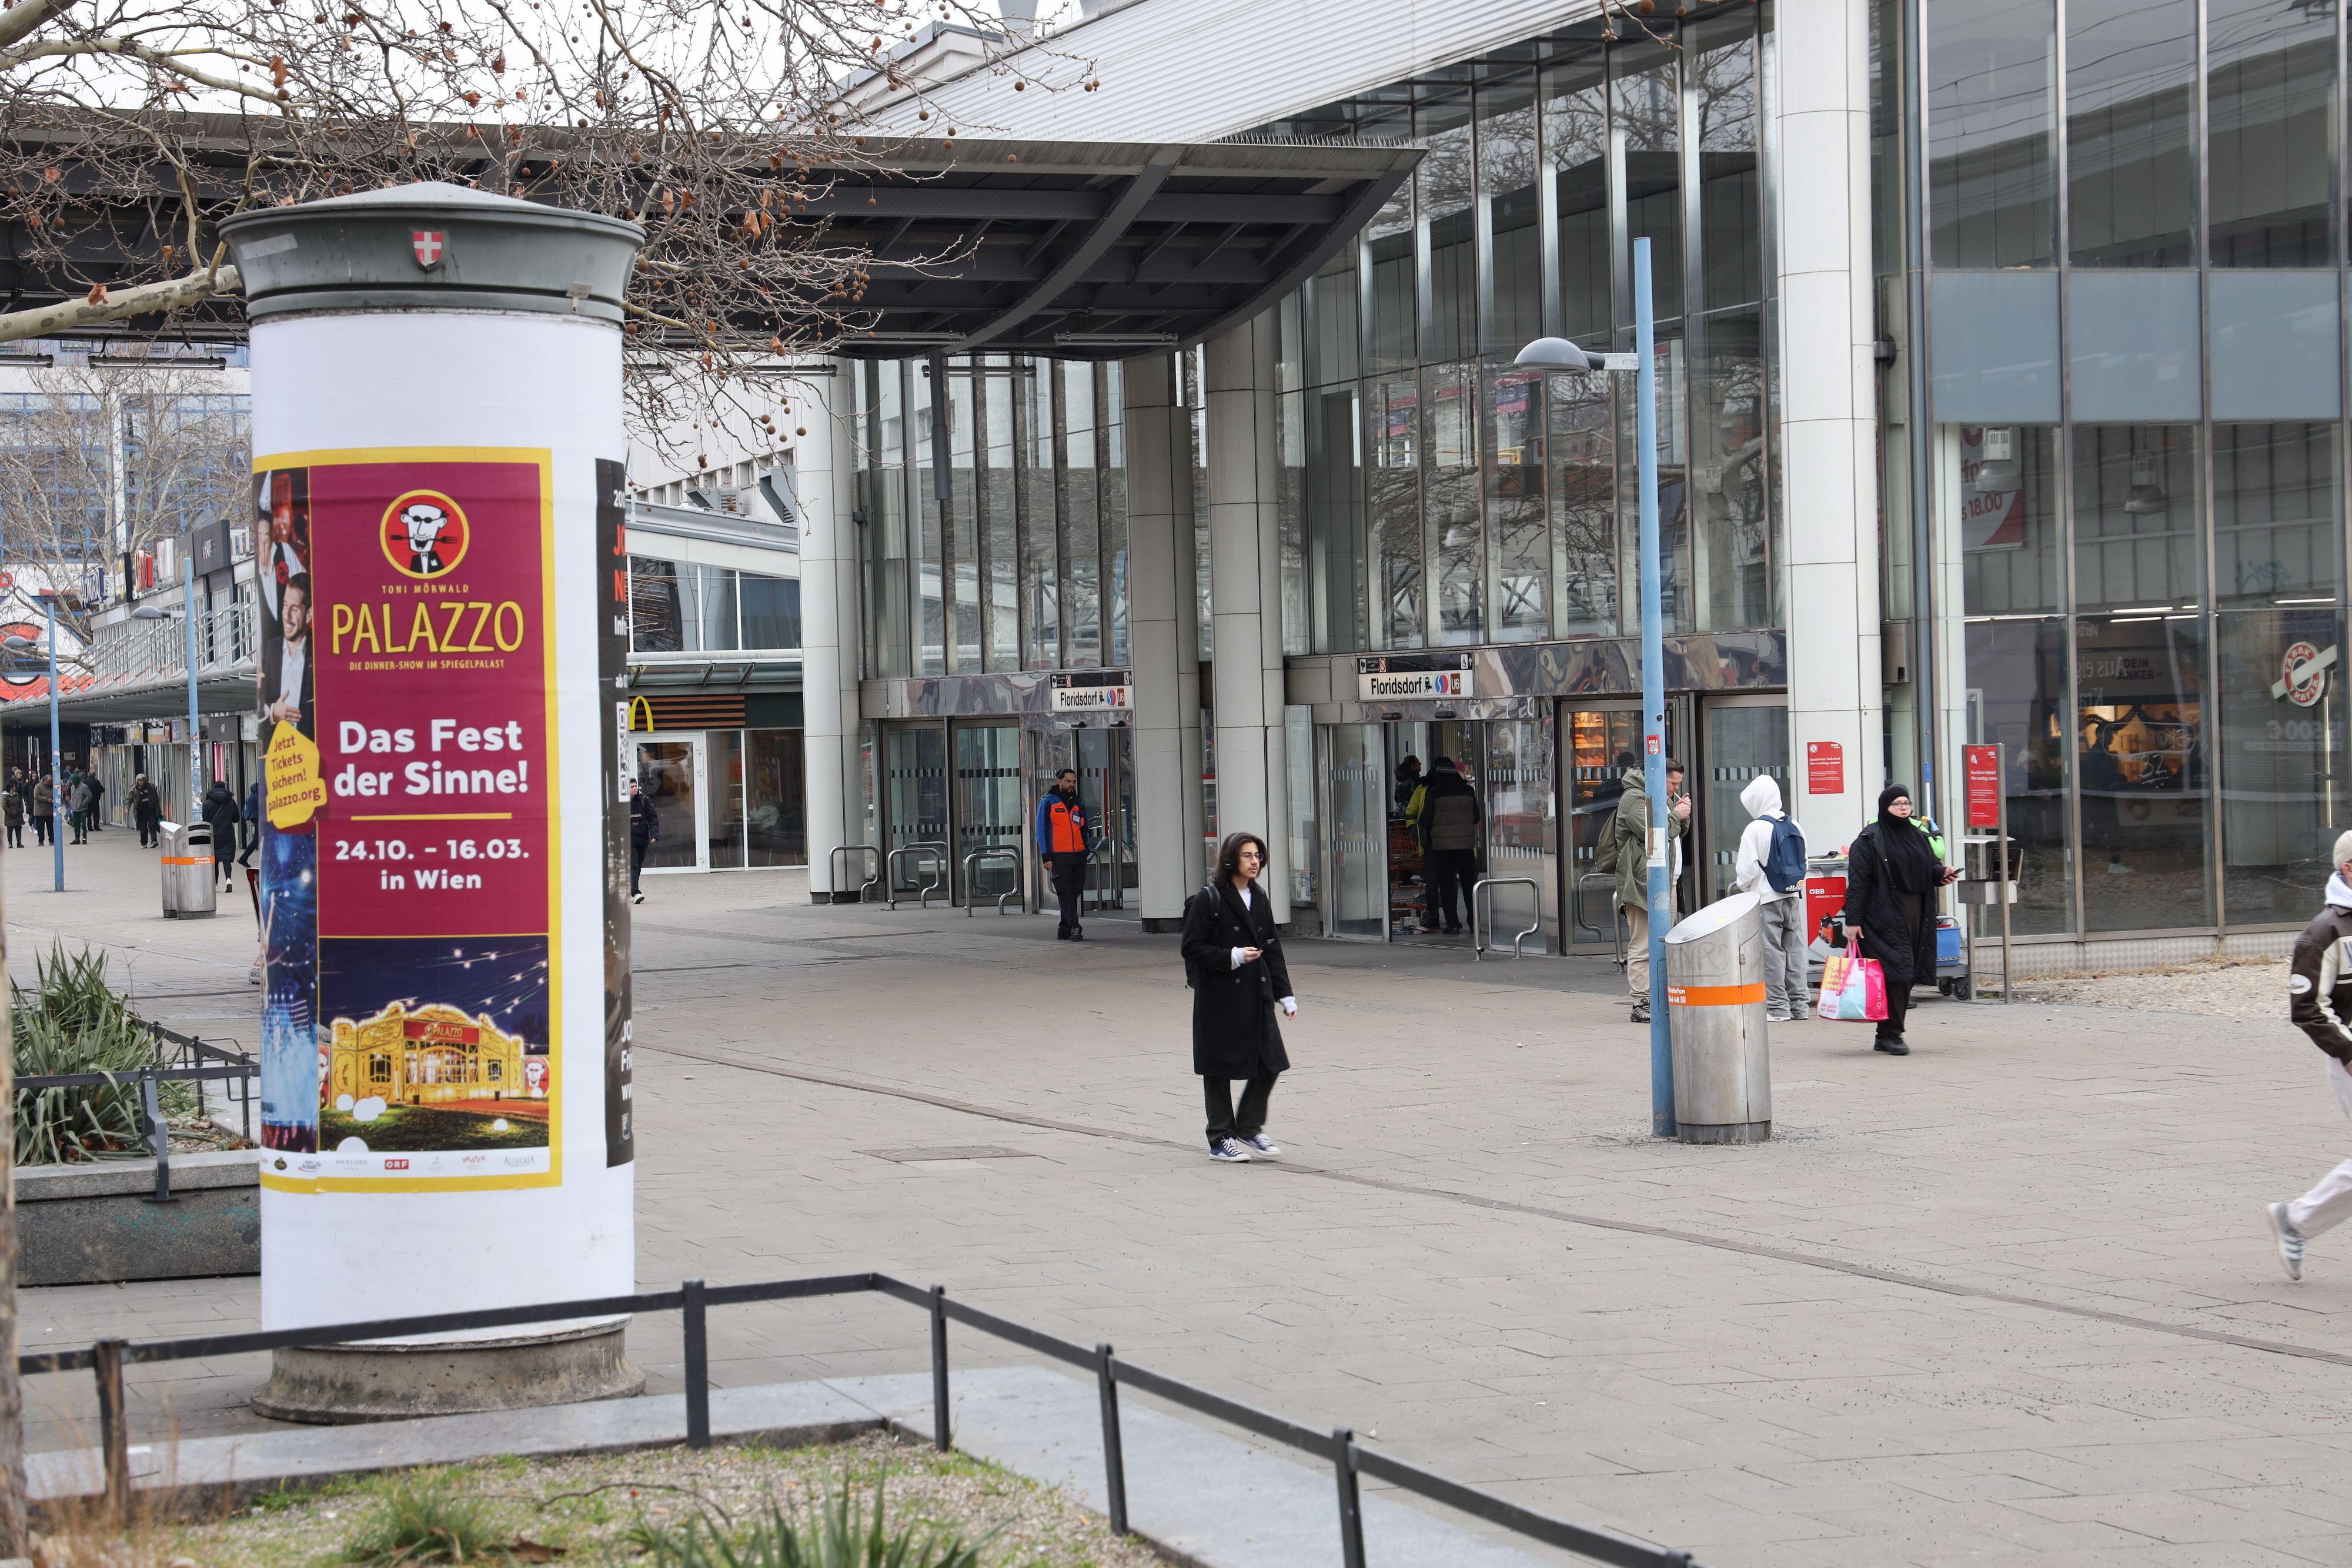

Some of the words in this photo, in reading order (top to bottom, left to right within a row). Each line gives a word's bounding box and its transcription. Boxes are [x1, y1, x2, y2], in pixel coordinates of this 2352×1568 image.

[1969, 493, 2003, 519] 18.00
[382, 585, 407, 594] TONI
[414, 583, 469, 593] MÖRWALD
[332, 600, 524, 654] PALAZZO
[349, 661, 362, 670] DIE
[365, 660, 423, 670] DINNER-SHOW
[427, 660, 437, 669] IM
[440, 659, 505, 669] SPIEGELPALAST
[2123, 658, 2150, 668] DEIN
[2286, 646, 2313, 674] TABAK
[2117, 669, 2155, 680] ANKER
[1371, 677, 1422, 695] Floridsdorf
[1451, 678, 1460, 690] U6
[2289, 680, 2318, 701] TRAFIK
[1060, 691, 1097, 706] Floridsdorf
[1118, 692, 1124, 702] U6
[273, 734, 296, 753] Jetzt
[339, 720, 415, 754] Das
[432, 718, 523, 752] Fest
[271, 753, 303, 772] Tickets
[272, 768, 308, 791] sichern!
[334, 763, 393, 796] der
[405, 760, 528, 795] Sinne!
[268, 787, 321, 815] palazzo.org
[335, 839, 415, 860] 24.10.
[446, 838, 529, 860] 16.03.
[381, 869, 405, 890] in
[414, 868, 482, 890] Wien
[433, 1027, 463, 1038] PALAZZO
[386, 1160, 407, 1169] ORF
[462, 1155, 485, 1164] PRATER
